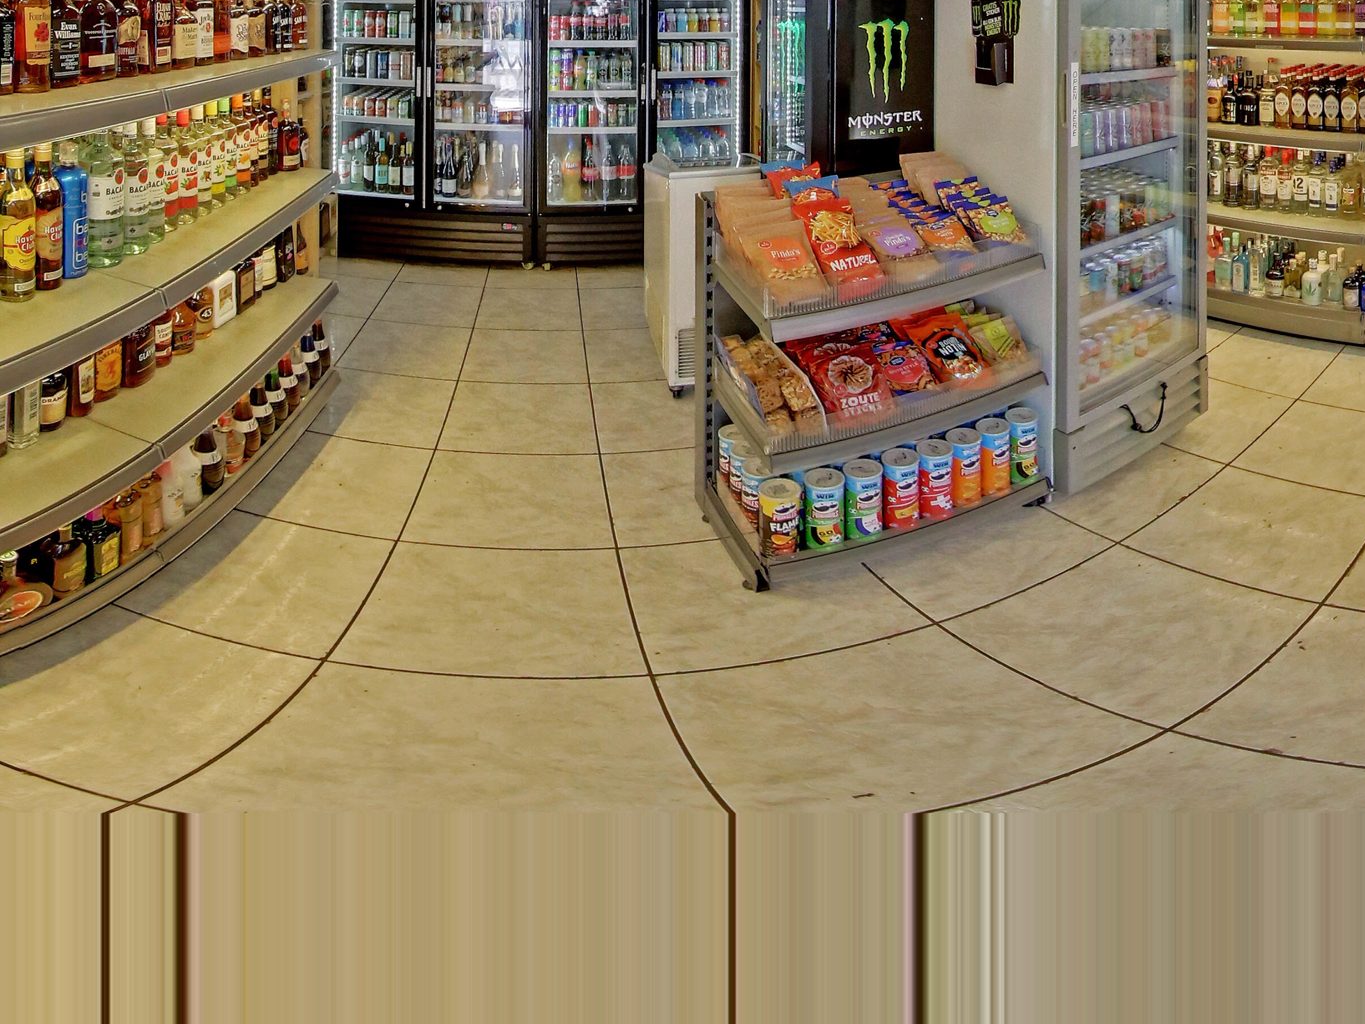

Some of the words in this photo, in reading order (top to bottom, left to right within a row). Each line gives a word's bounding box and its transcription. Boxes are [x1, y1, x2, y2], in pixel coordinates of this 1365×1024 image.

[61, 22, 77, 30] Evan
[55, 30, 81, 39] Williams
[848, 109, 923, 131] MONSTER
[860, 125, 913, 137] ENERGY
[885, 234, 911, 248] Pinda's
[771, 248, 800, 258] Pinda's
[830, 254, 876, 272] NATUREL
[200, 307, 213, 320] 43
[840, 392, 880, 409] ZOUTE
